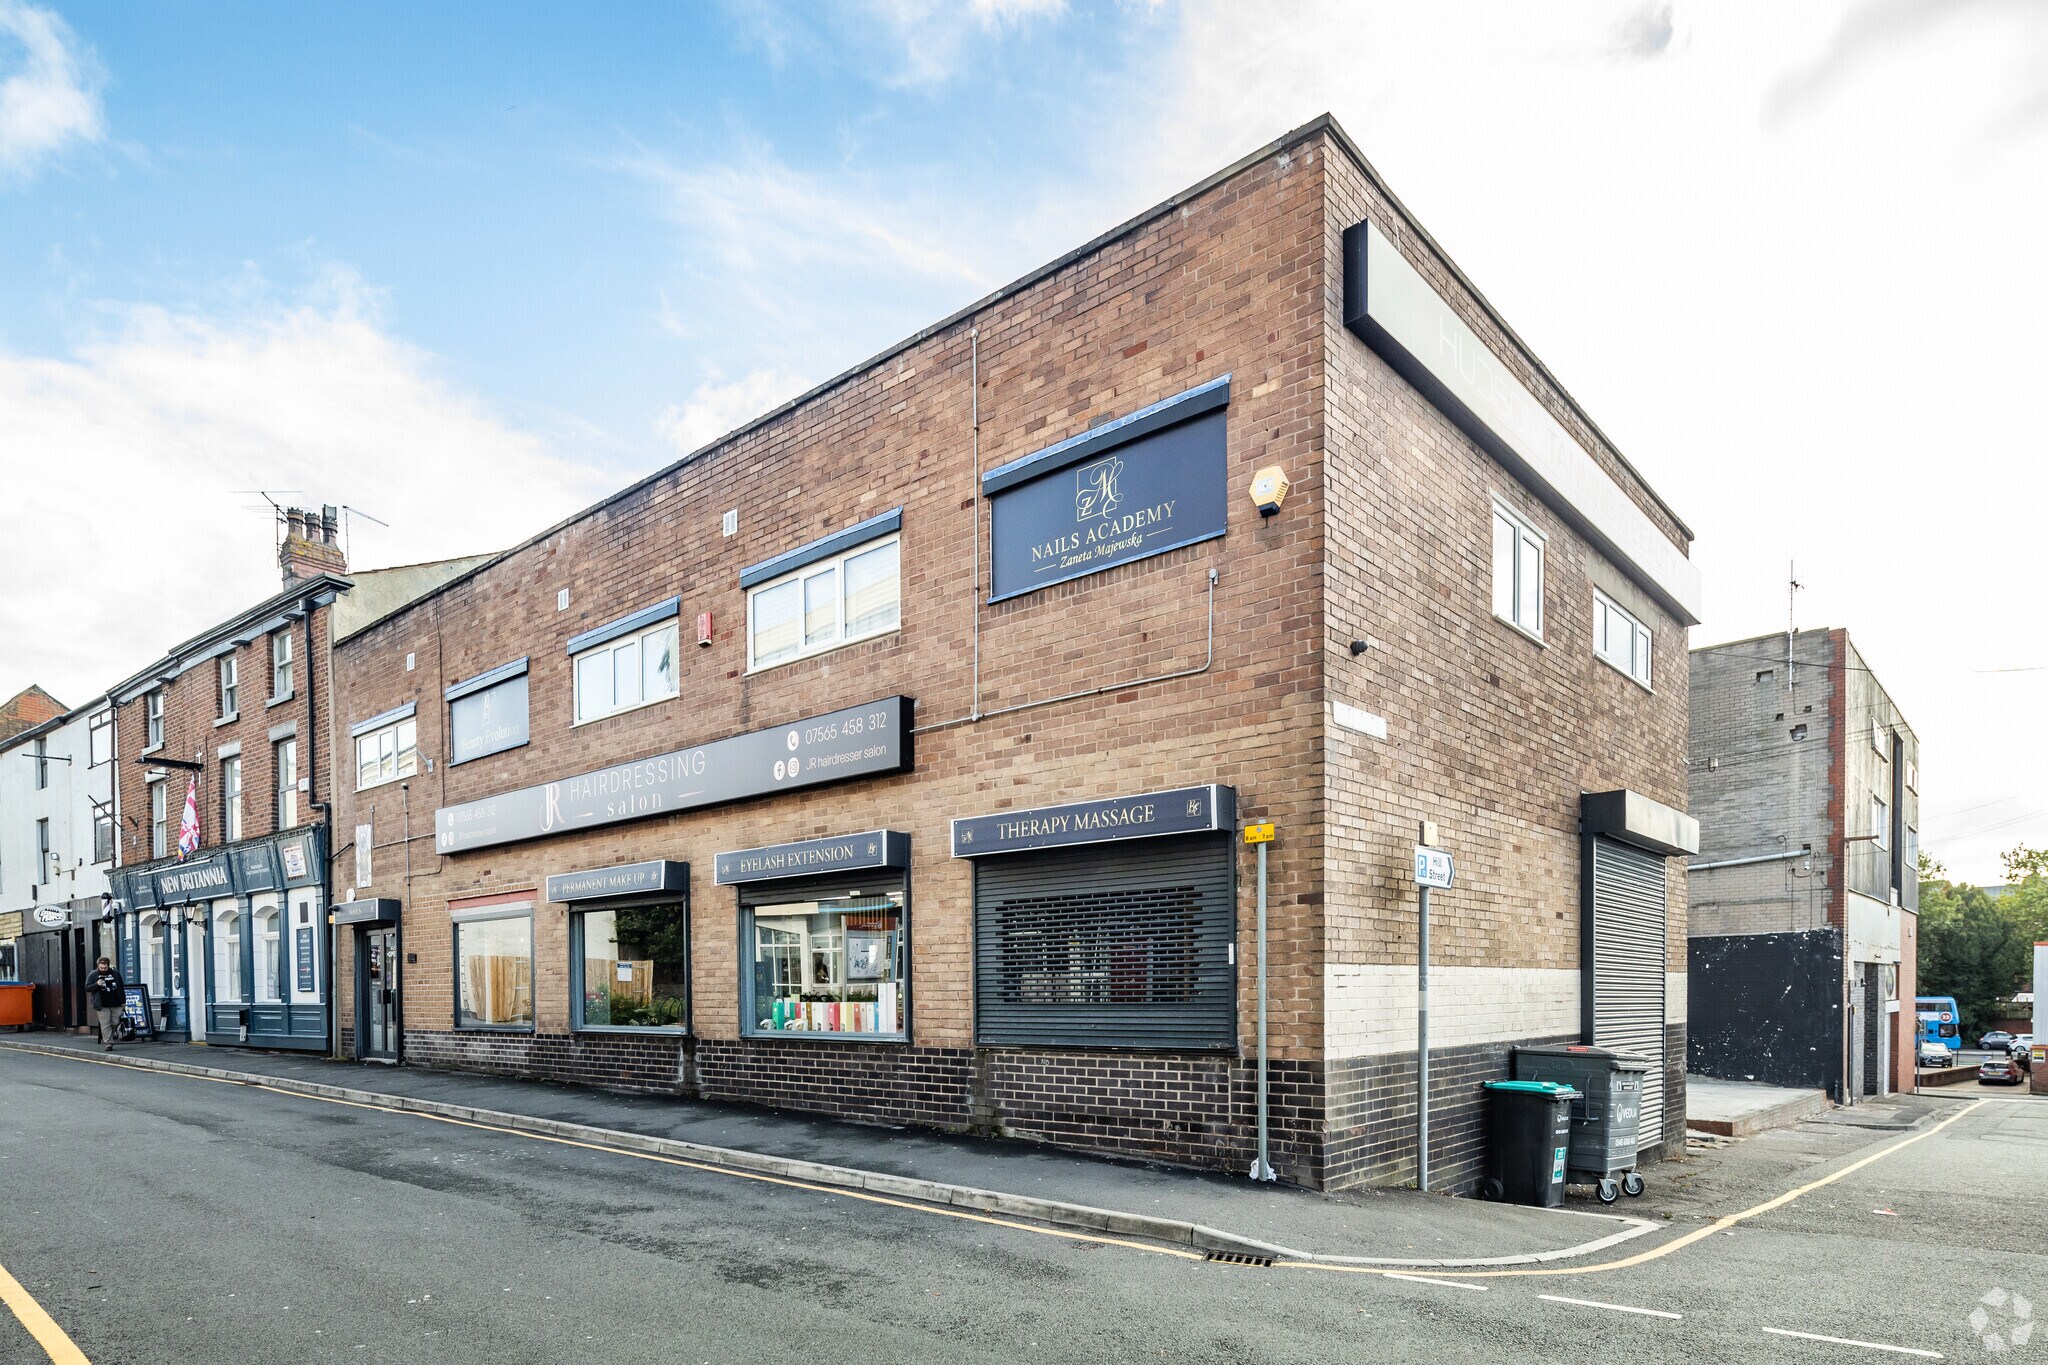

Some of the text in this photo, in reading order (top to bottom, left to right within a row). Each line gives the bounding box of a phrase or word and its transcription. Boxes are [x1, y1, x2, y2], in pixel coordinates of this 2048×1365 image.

[1031, 500, 1176, 562] NAILS ACADEMY
[1059, 532, 1143, 569] Zaneta Majewska
[461, 724, 520, 752] Beauty Evolution
[805, 711, 887, 745] 07565 458 312
[805, 744, 887, 771] JR hairdresser salon
[539, 750, 706, 832] JR HAIRDRESSING
[607, 791, 662, 817] salon
[996, 804, 1155, 840] THERAPY MASSAGE
[740, 856, 785, 873] EYELASH
[788, 844, 854, 867] EXTENSION
[160, 875, 180, 895] NEW
[180, 866, 228, 892] BRITANNIA
[562, 871, 645, 894] PERMANENT MAKE UP
[1429, 868, 1446, 882] Street
